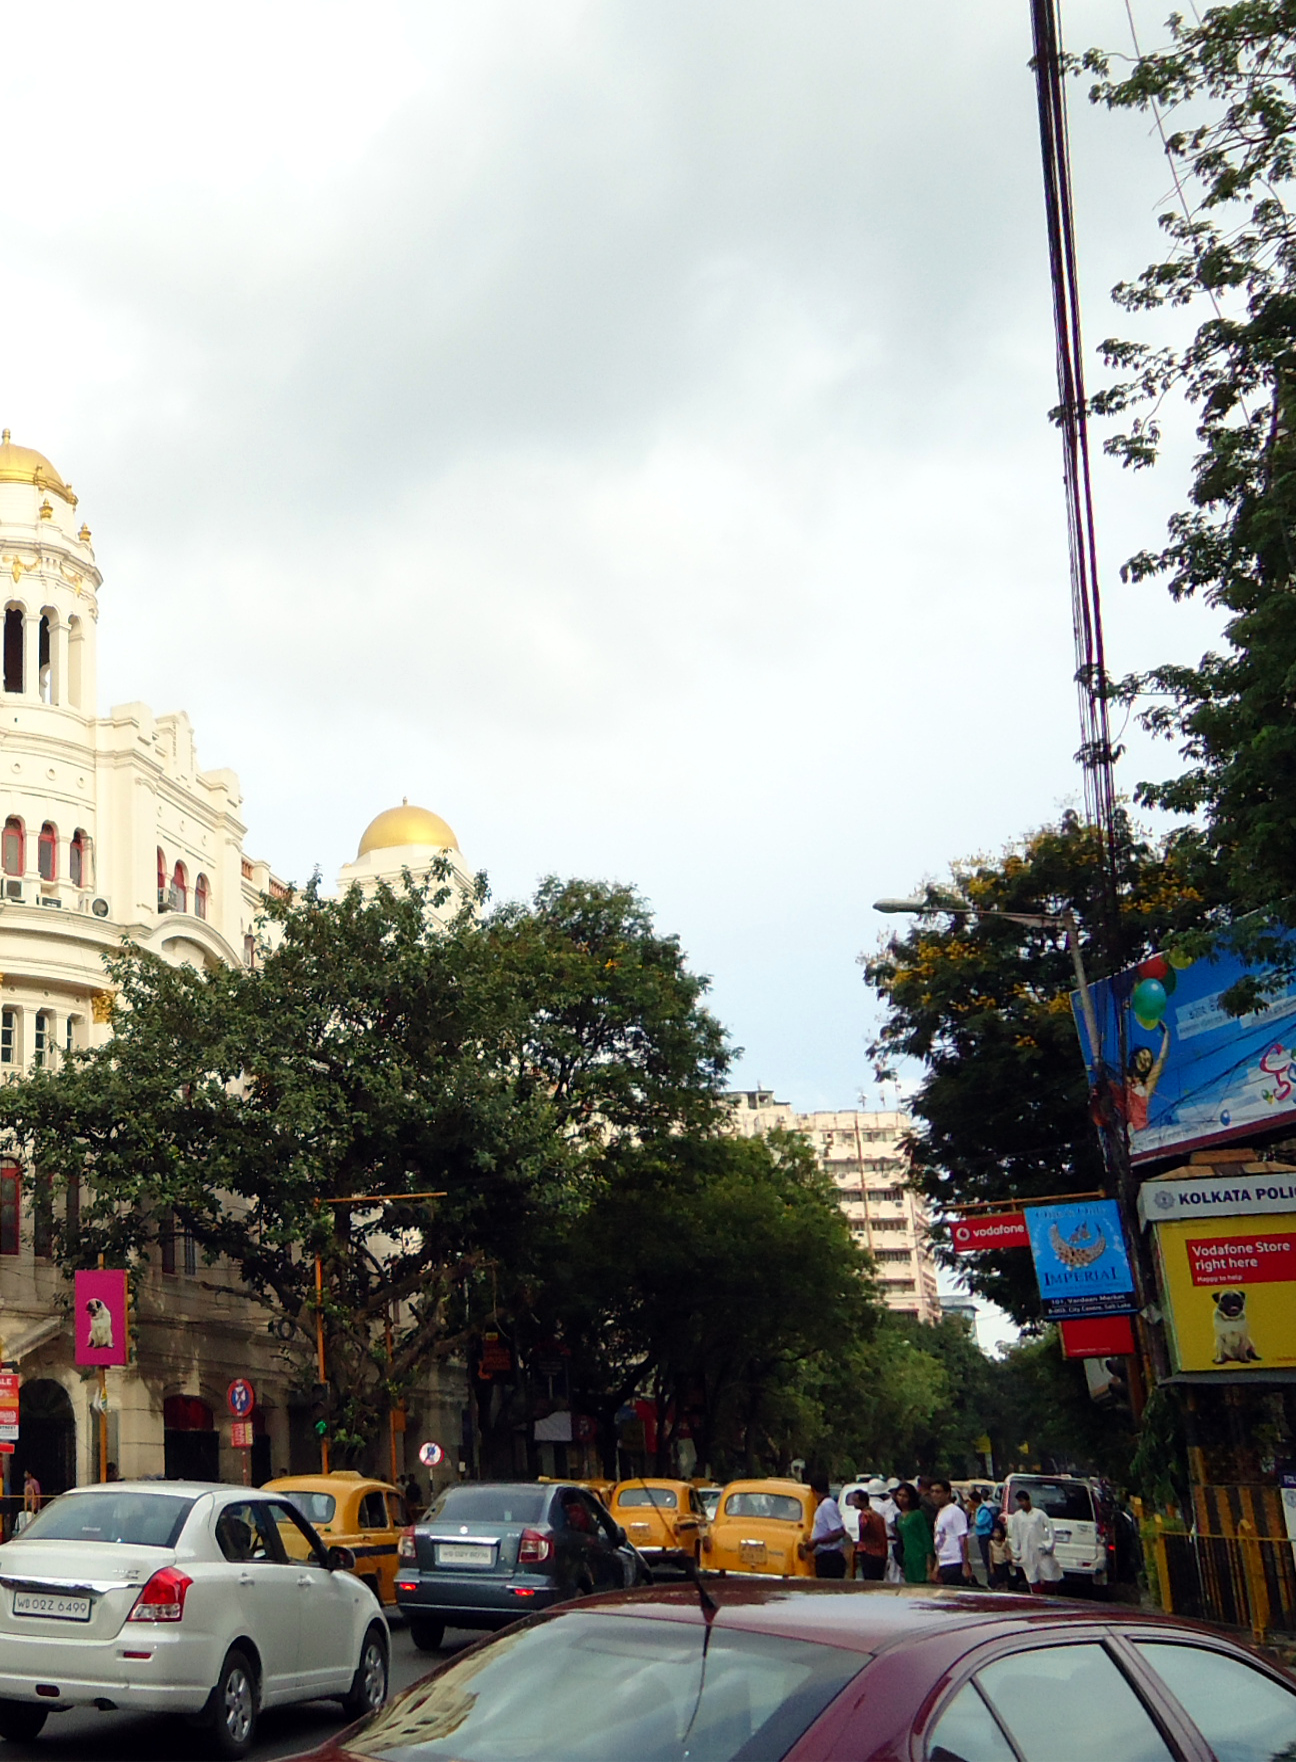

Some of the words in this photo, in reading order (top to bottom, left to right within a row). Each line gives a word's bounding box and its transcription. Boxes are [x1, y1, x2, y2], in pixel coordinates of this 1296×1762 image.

[1179, 1189, 1252, 1205] KOLKATA
[1256, 1186, 1296, 1200] POLI
[973, 1224, 1024, 1237] vodafone
[1192, 1243, 1253, 1257] Vodafone
[1255, 1241, 1290, 1253] Store
[1195, 1258, 1227, 1273] right
[1229, 1257, 1258, 1268] here
[58, 1602, 87, 1613] 6499
